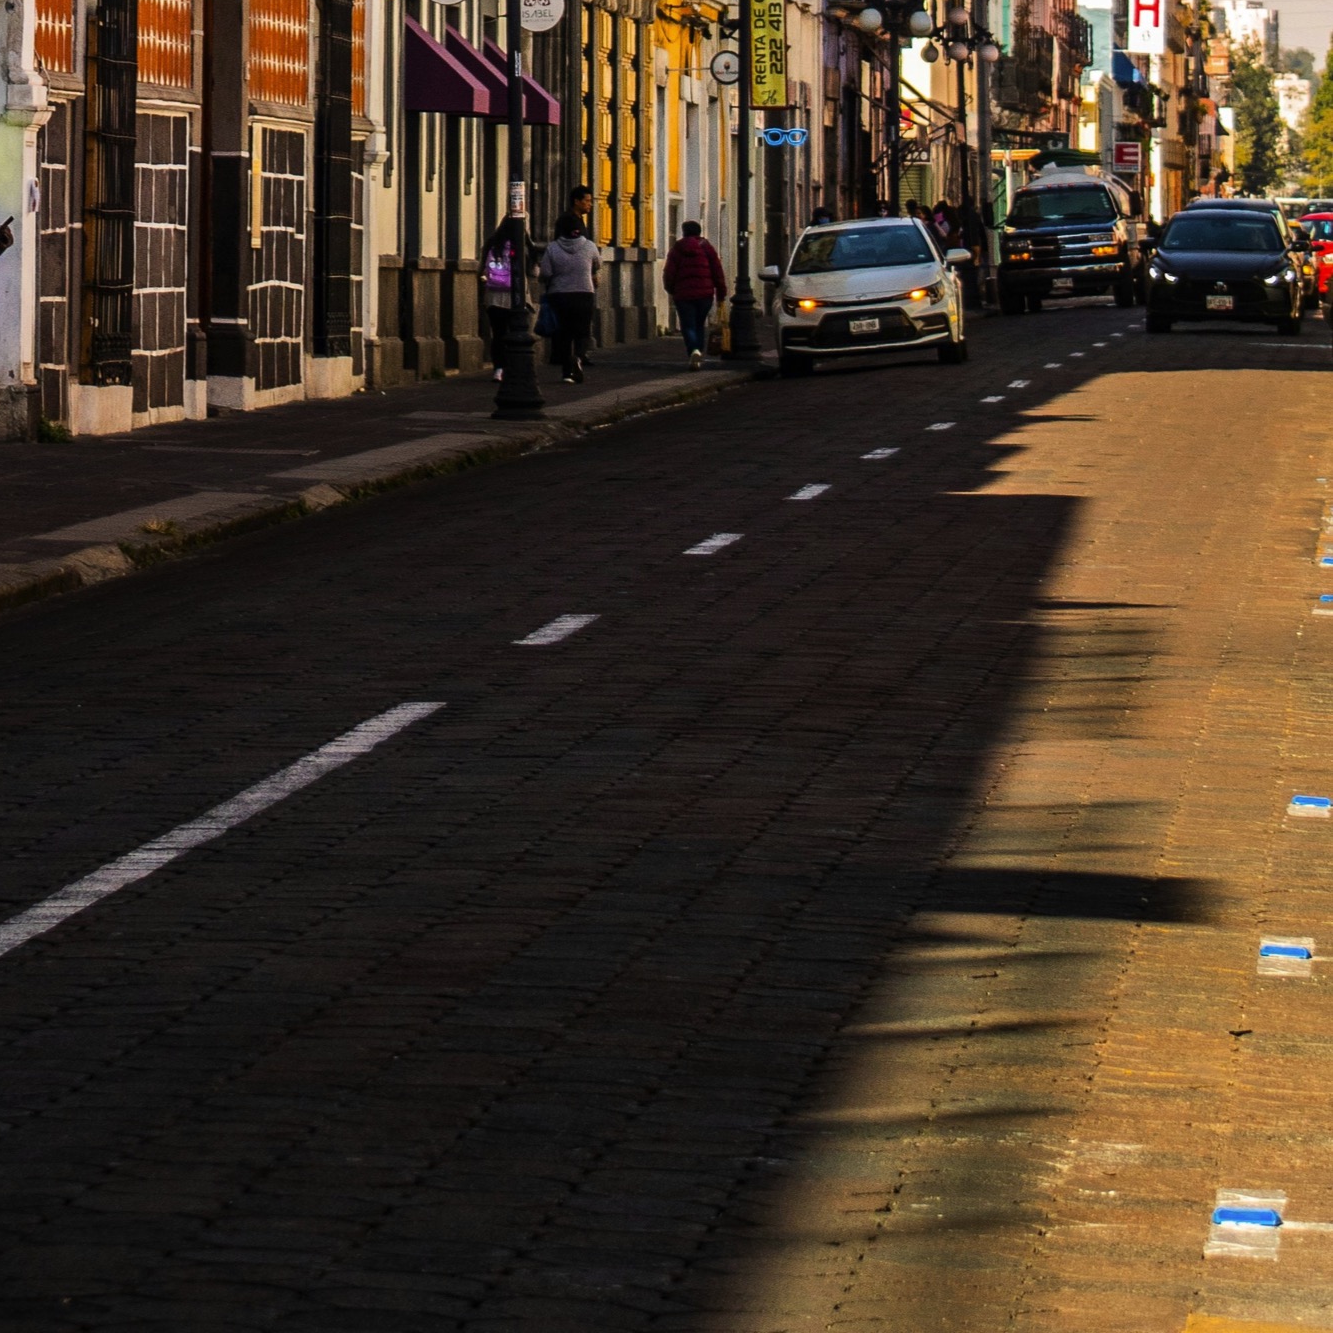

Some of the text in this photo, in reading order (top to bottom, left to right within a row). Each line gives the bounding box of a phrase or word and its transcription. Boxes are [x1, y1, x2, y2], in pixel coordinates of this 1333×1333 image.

[522, 9, 554, 19] ISABEL
[754, 7, 766, 29] DE
[768, 2, 782, 32] 413
[755, 35, 767, 85] RENTA
[770, 37, 783, 75] 222
